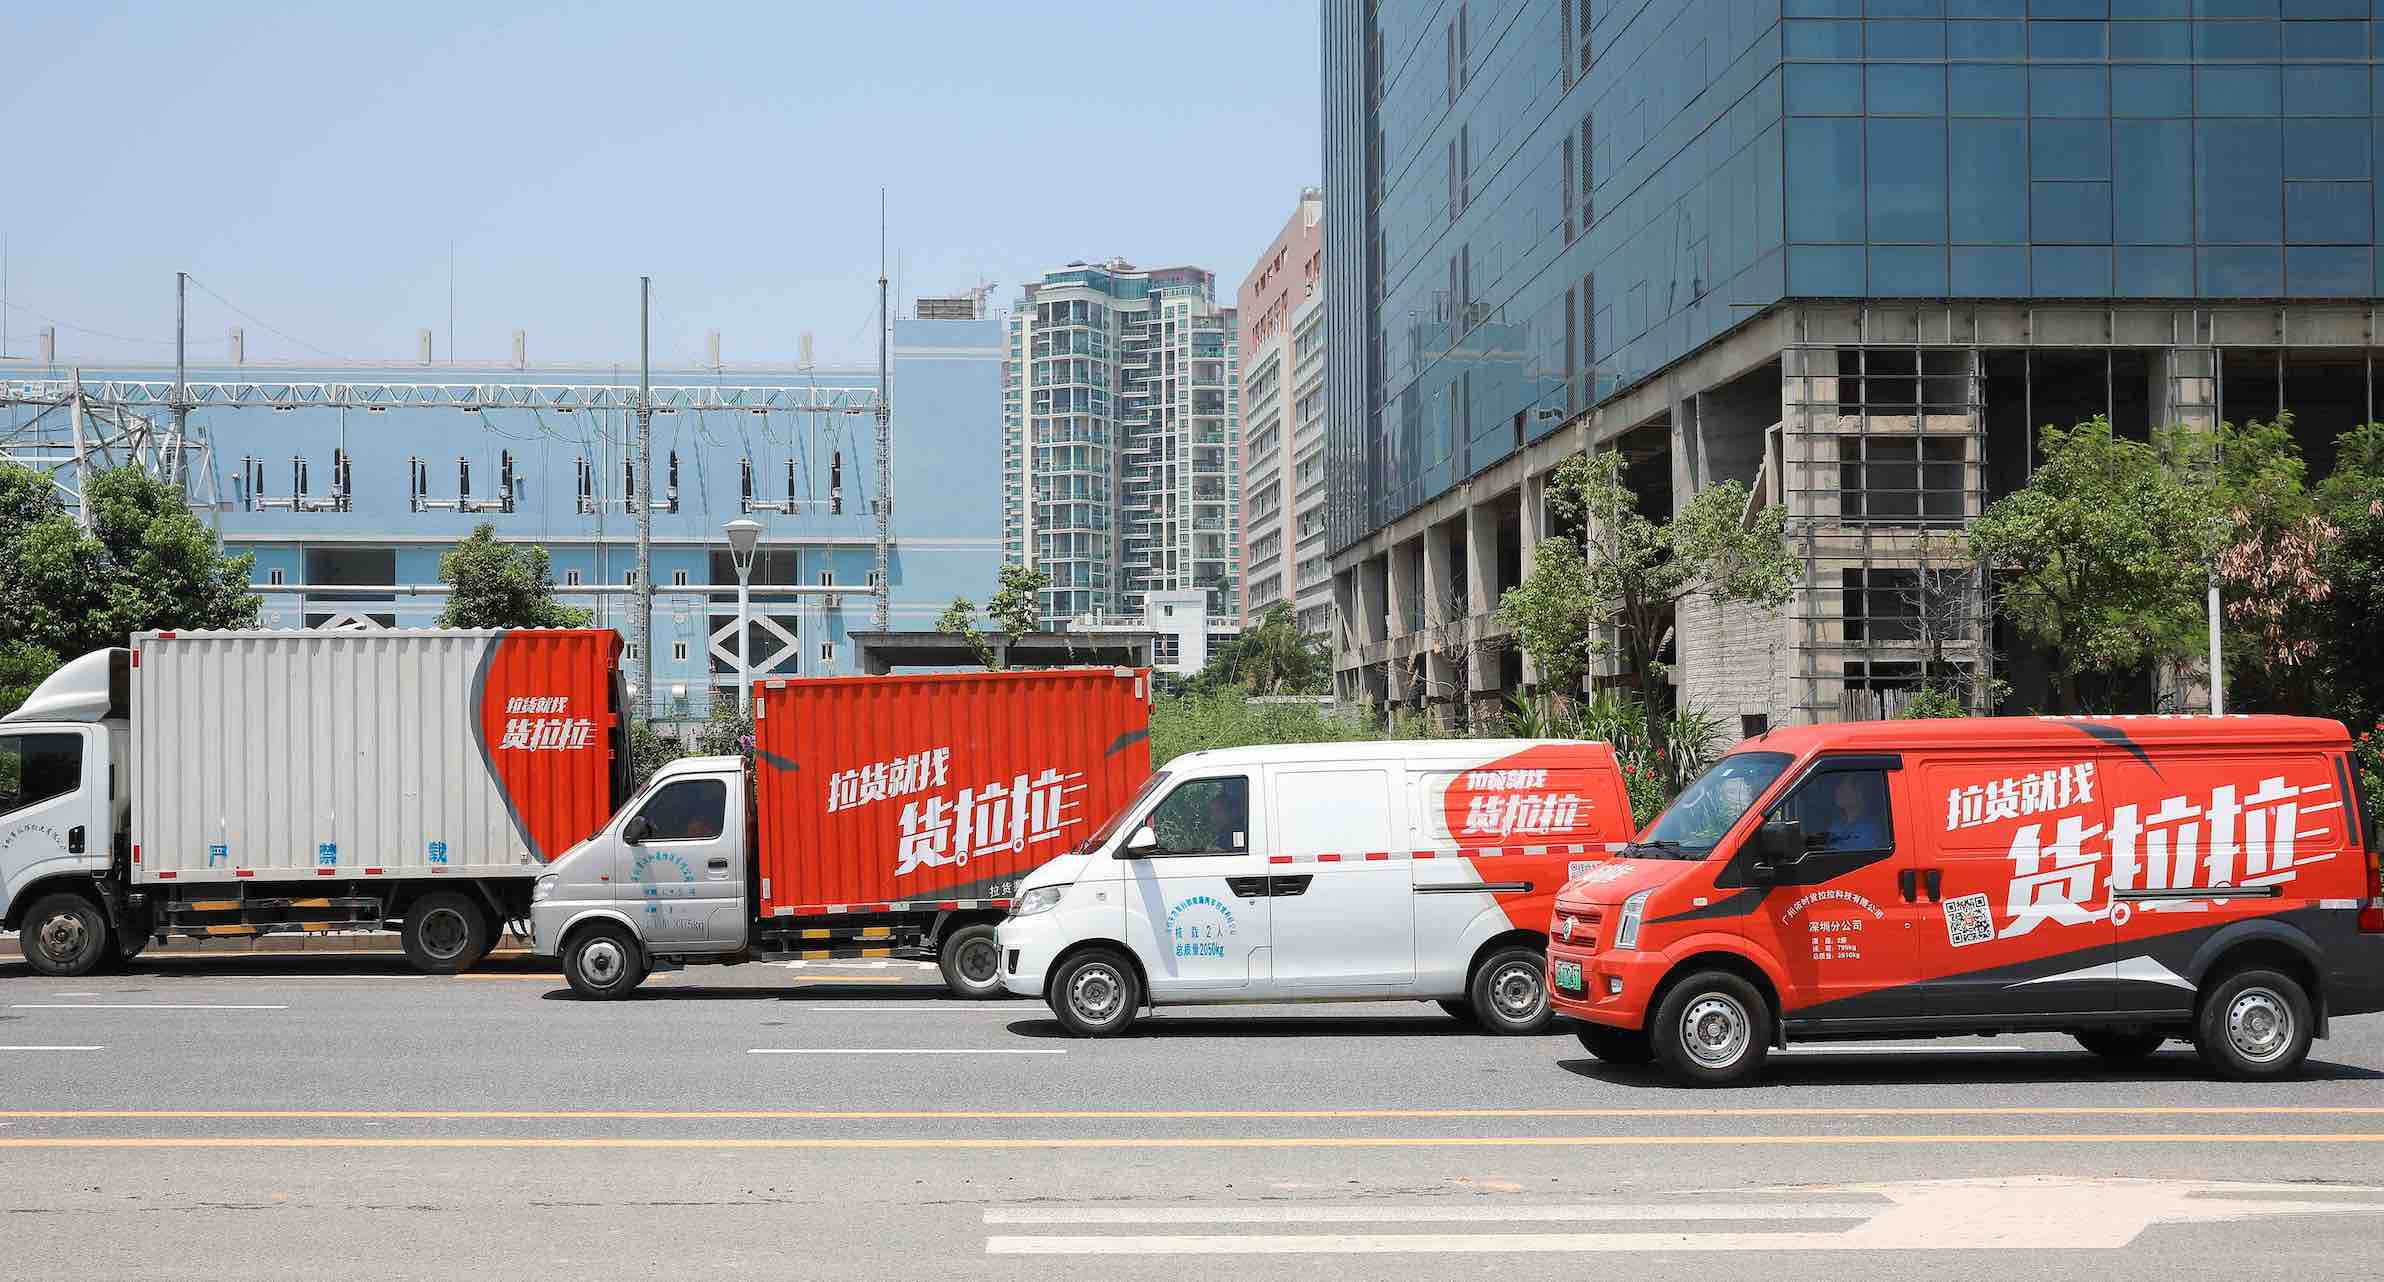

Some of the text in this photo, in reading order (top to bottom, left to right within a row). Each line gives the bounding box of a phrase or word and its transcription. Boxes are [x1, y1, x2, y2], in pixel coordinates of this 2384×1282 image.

[505, 696, 568, 713] 拉货就找
[498, 718, 593, 752] 货拉拉
[828, 747, 950, 812] 拉货就找
[1946, 762, 2095, 831] 拉货就找
[895, 768, 1066, 877] 货拉拉
[1461, 793, 1581, 836] 货拉拉
[1998, 775, 2304, 939] 货拉拉
[1809, 920, 1862, 932] 深圳分公司
